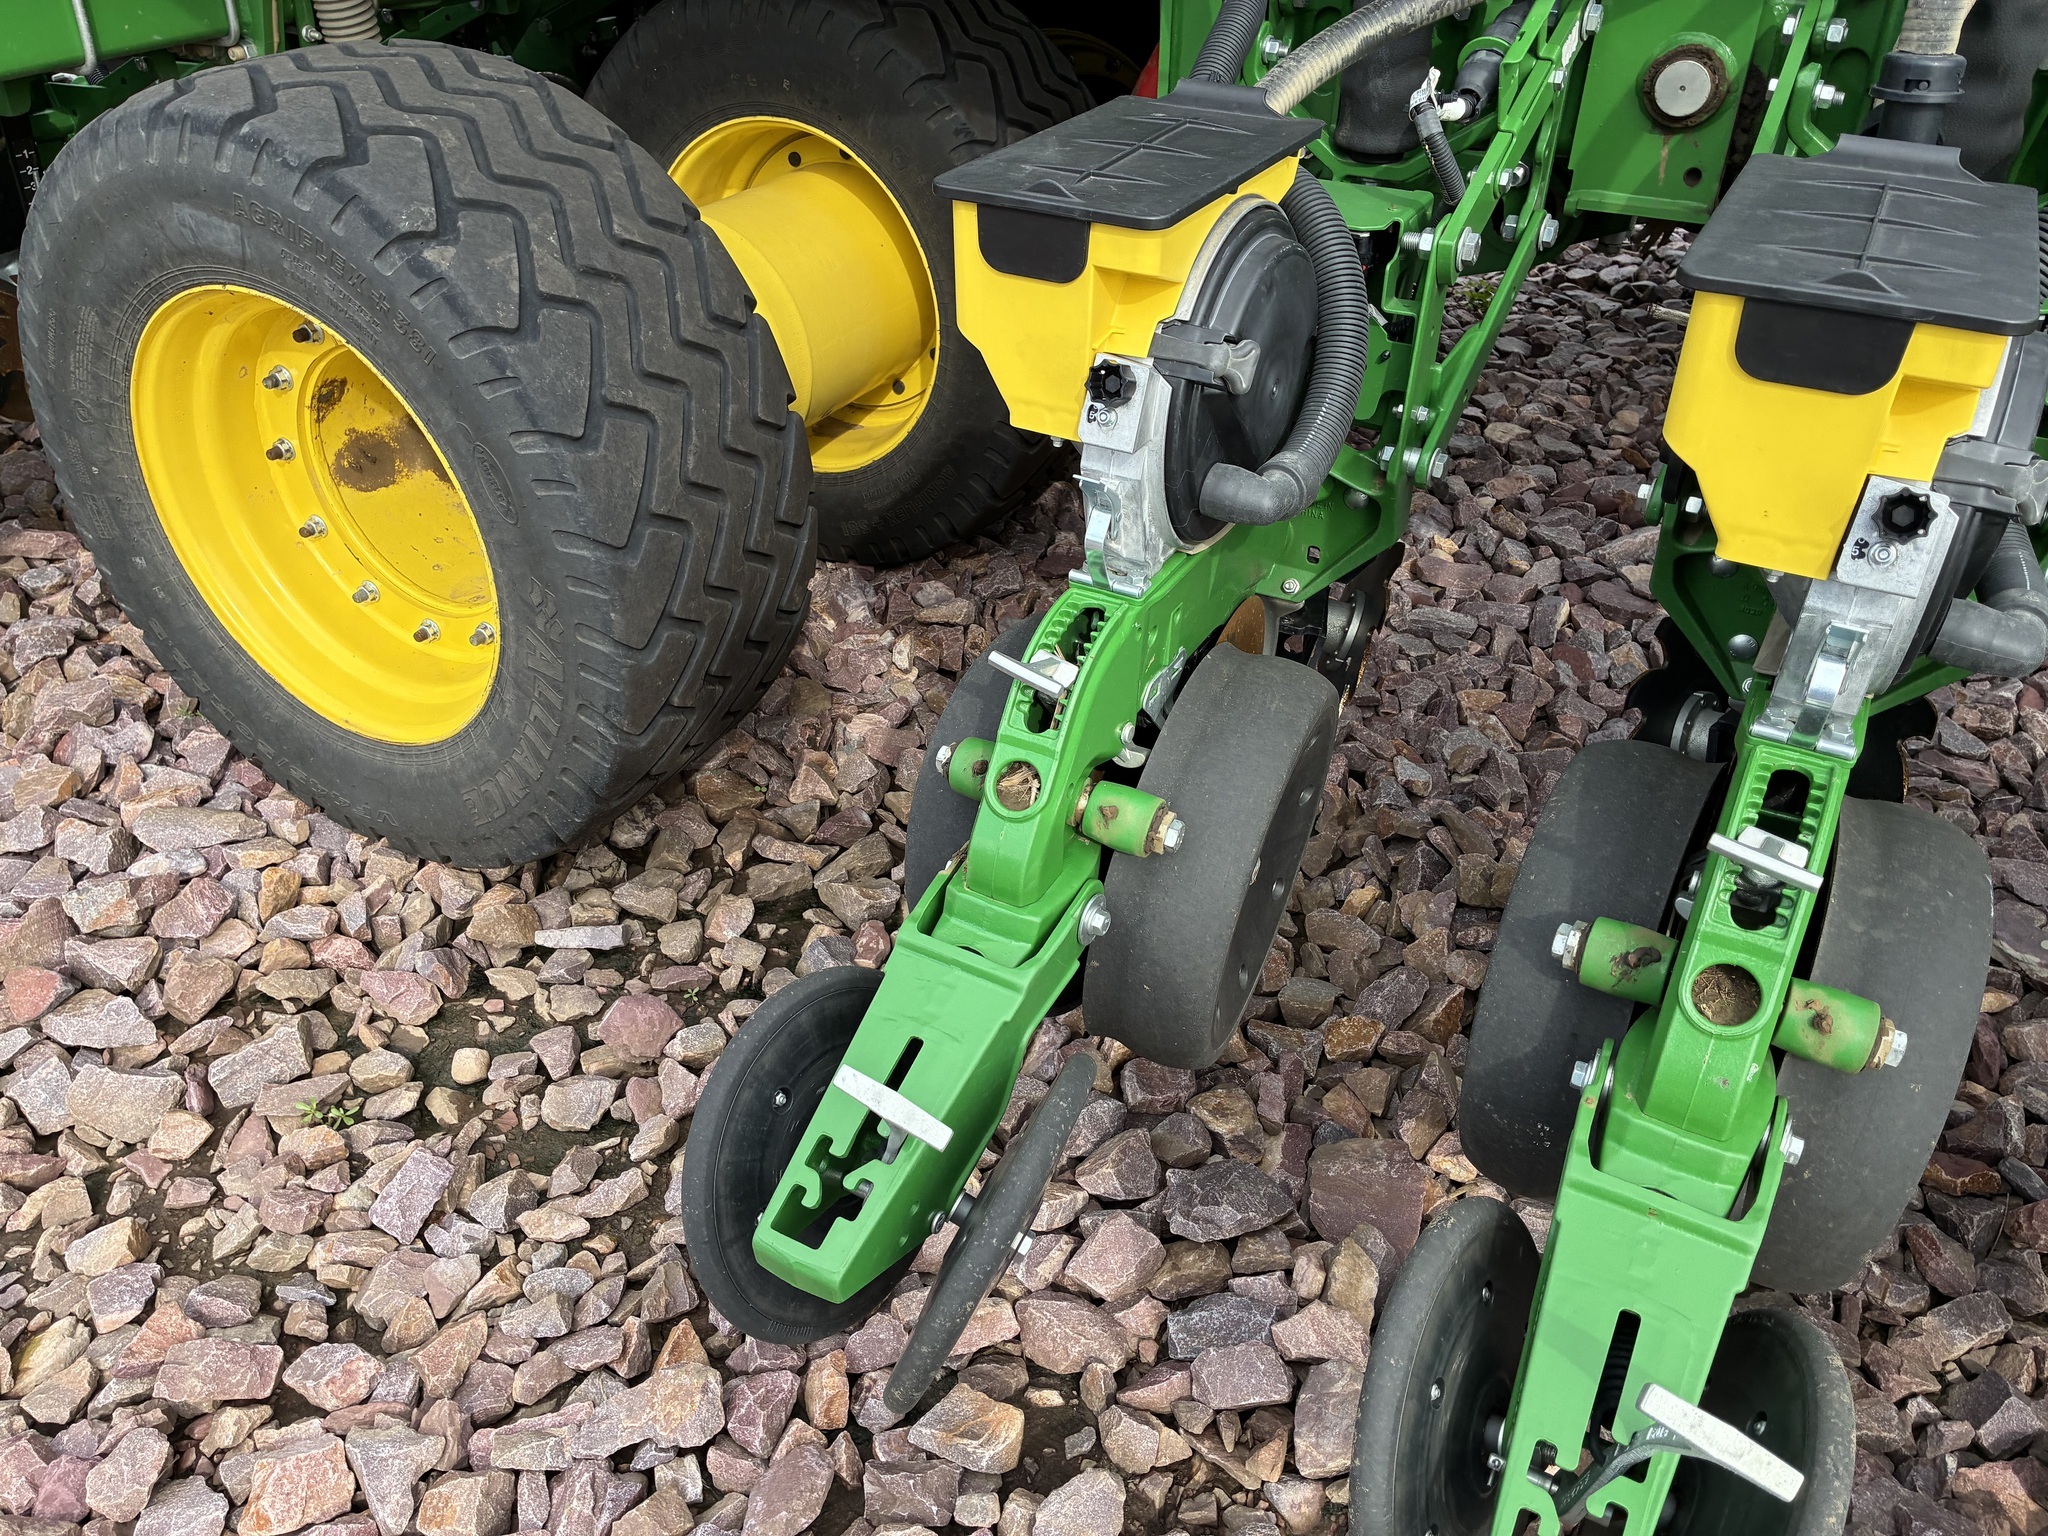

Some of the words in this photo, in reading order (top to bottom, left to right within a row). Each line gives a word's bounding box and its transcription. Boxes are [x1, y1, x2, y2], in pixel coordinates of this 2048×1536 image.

[23, 149, 29, 159] 1
[26, 165, 33, 175] 2
[232, 191, 368, 294] AGRIFLEX
[392, 309, 438, 367] 381
[461, 624, 566, 828] ALLIANCE
